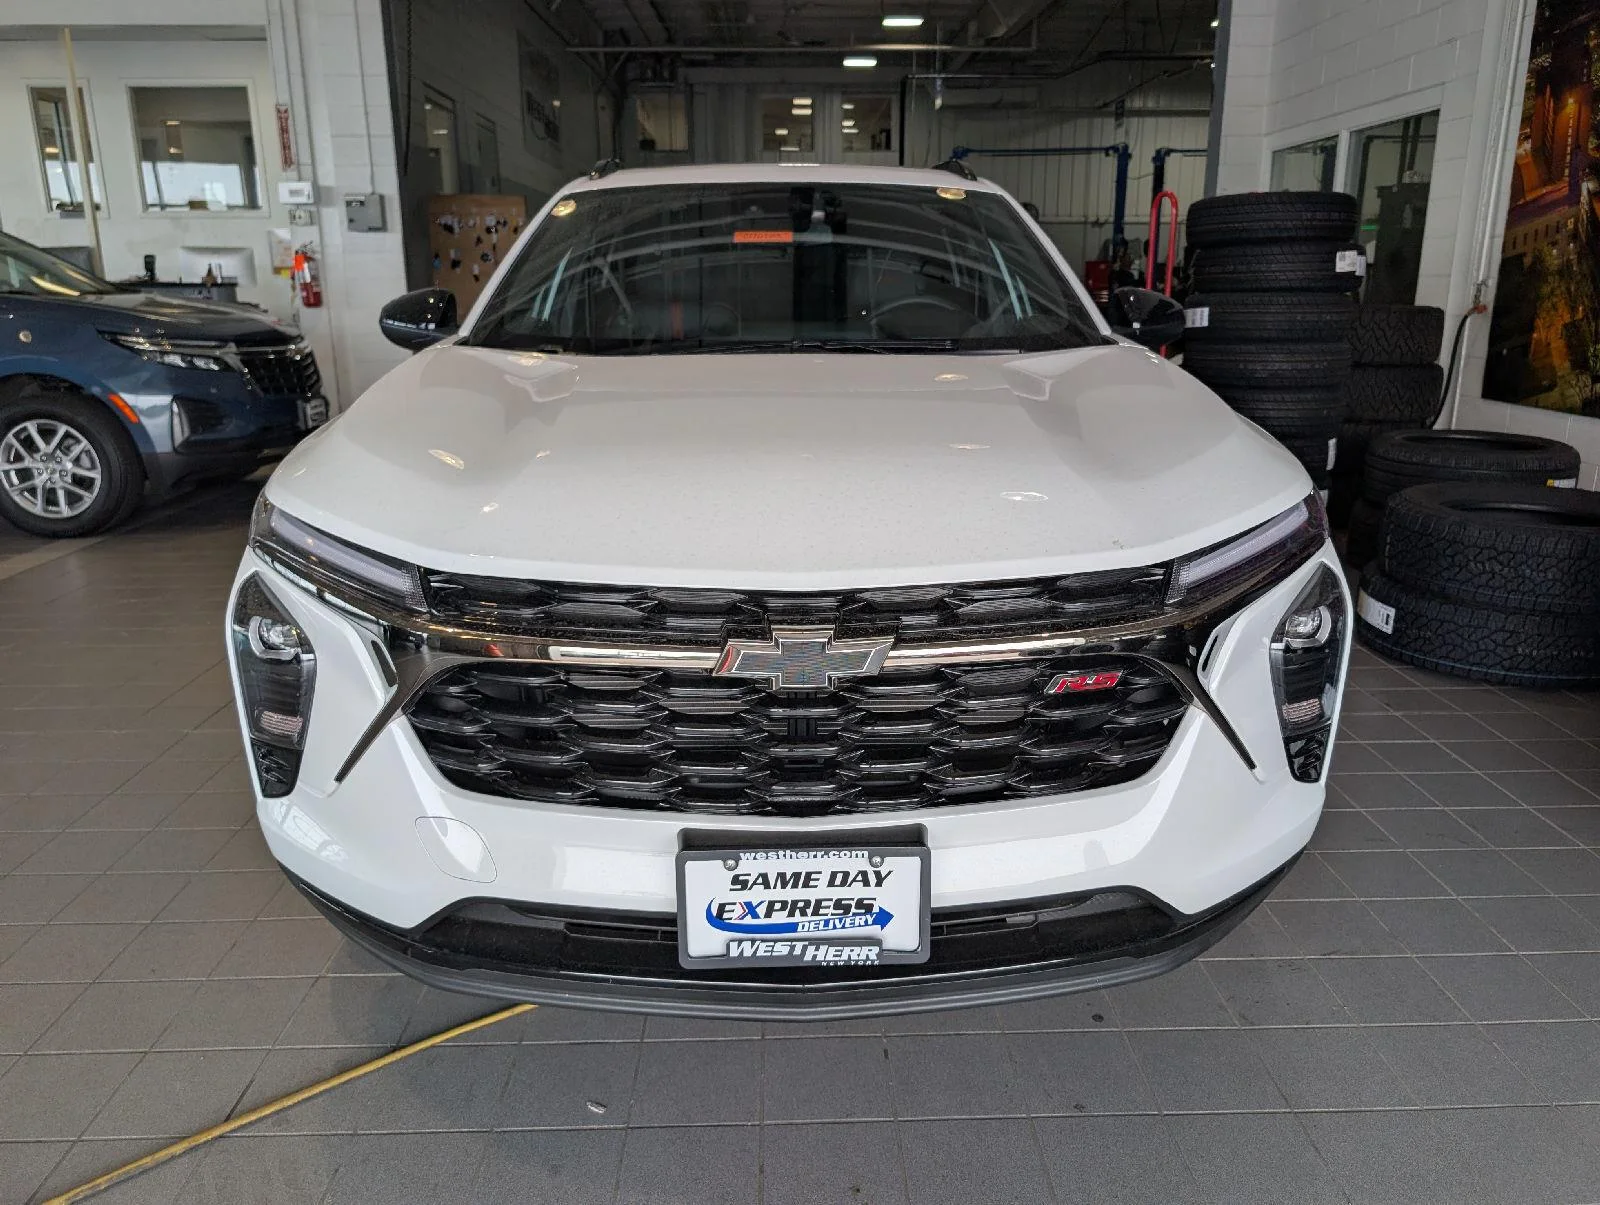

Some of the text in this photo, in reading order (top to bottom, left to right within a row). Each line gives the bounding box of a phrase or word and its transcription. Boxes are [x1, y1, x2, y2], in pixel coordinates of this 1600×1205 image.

[1044, 670, 1122, 694] RS
[740, 850, 868, 861] westherr.com
[729, 870, 893, 892] SAME DAY
[716, 897, 877, 920] EXPRESS
[797, 913, 877, 932] DELIVERY
